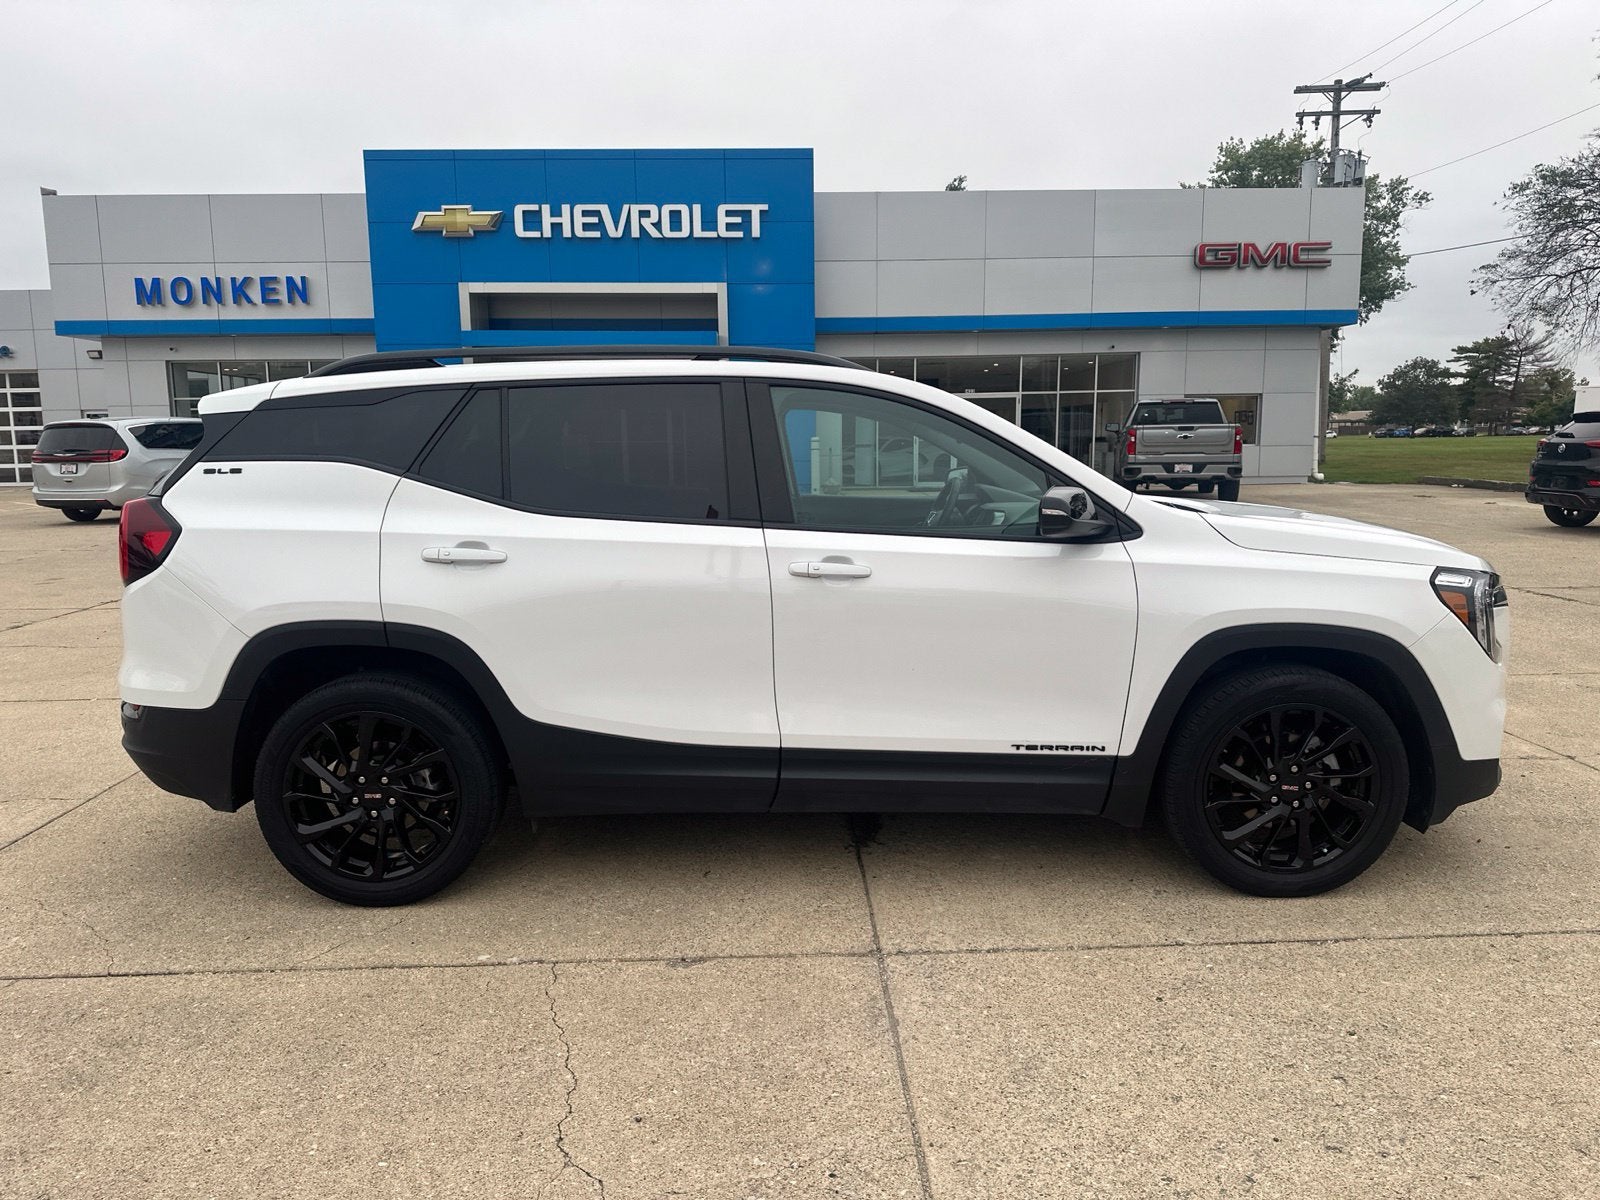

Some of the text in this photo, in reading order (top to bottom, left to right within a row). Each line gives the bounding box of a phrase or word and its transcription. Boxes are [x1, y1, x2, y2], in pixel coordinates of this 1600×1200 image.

[514, 203, 769, 239] CHEVROLET
[1193, 241, 1333, 269] GMC
[134, 275, 310, 306] MONKEN
[1011, 744, 1106, 752] TERRAIN
